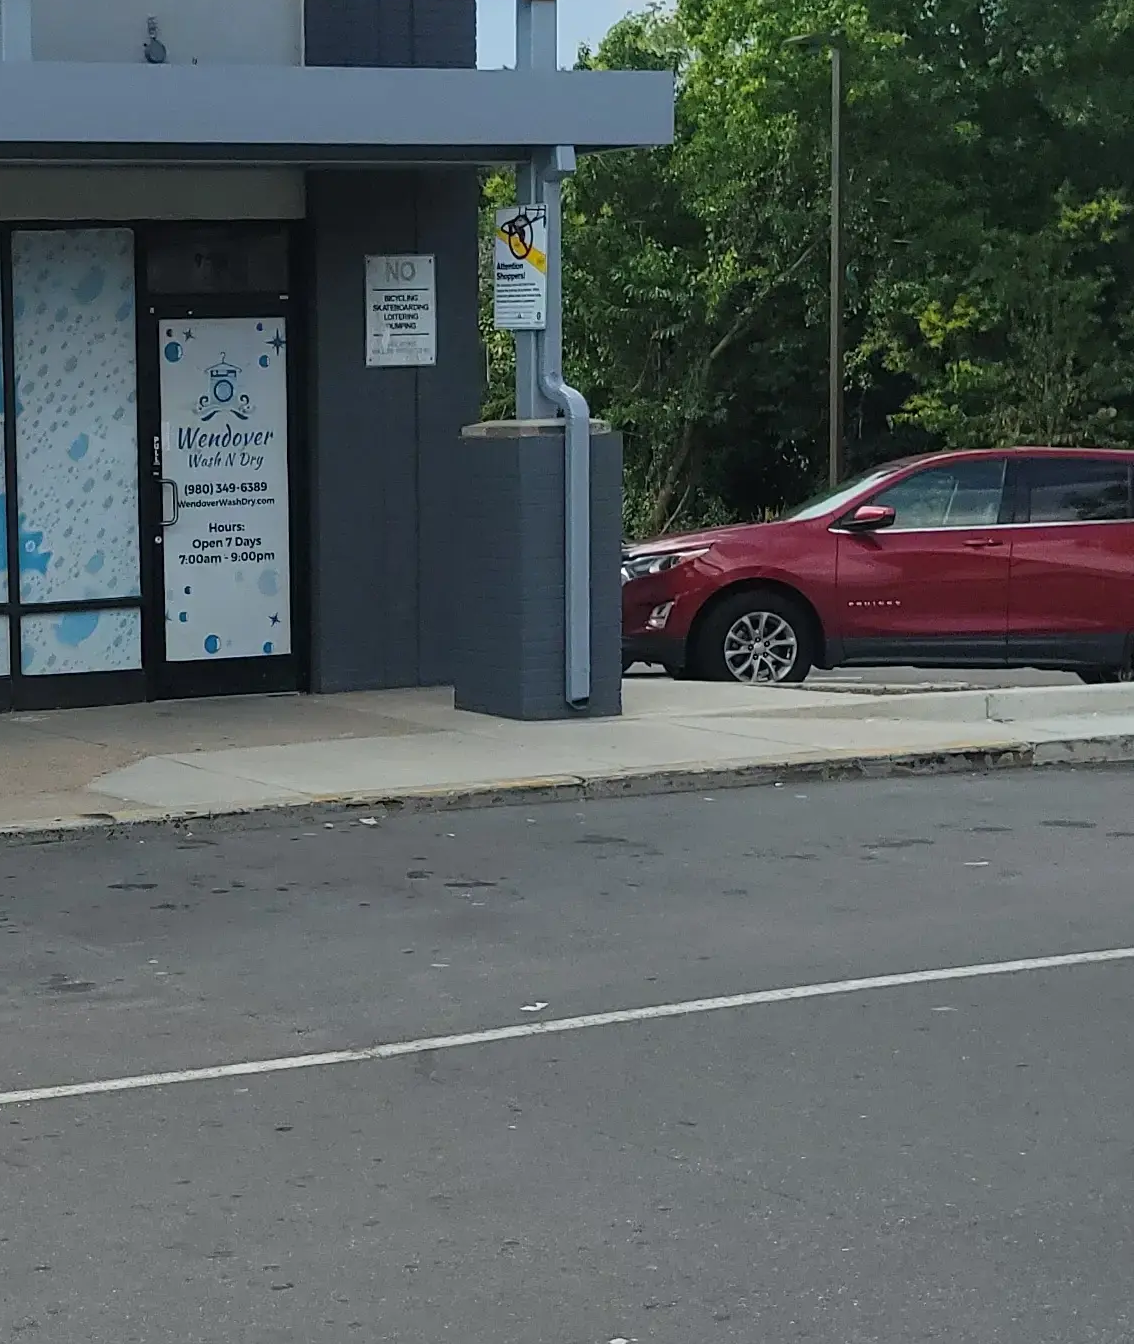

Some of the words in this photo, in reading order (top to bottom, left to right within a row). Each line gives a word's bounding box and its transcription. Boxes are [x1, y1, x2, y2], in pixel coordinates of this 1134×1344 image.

[385, 259, 416, 283] NO
[384, 294, 419, 302] BICYCLING
[372, 303, 429, 312] SKATEBOARDING
[177, 423, 274, 450] Wendover
[188, 452, 222, 468] Wash
[224, 452, 237, 467] N
[239, 452, 264, 471] Dry
[184, 483, 214, 496] (980)
[215, 481, 268, 494] 349-6389
[208, 522, 246, 533] Hours:
[192, 538, 223, 551] Open
[225, 537, 233, 547] 7
[235, 536, 262, 548] Days
[178, 554, 222, 565] 7:00am
[230, 551, 275, 563] 9:00pm
